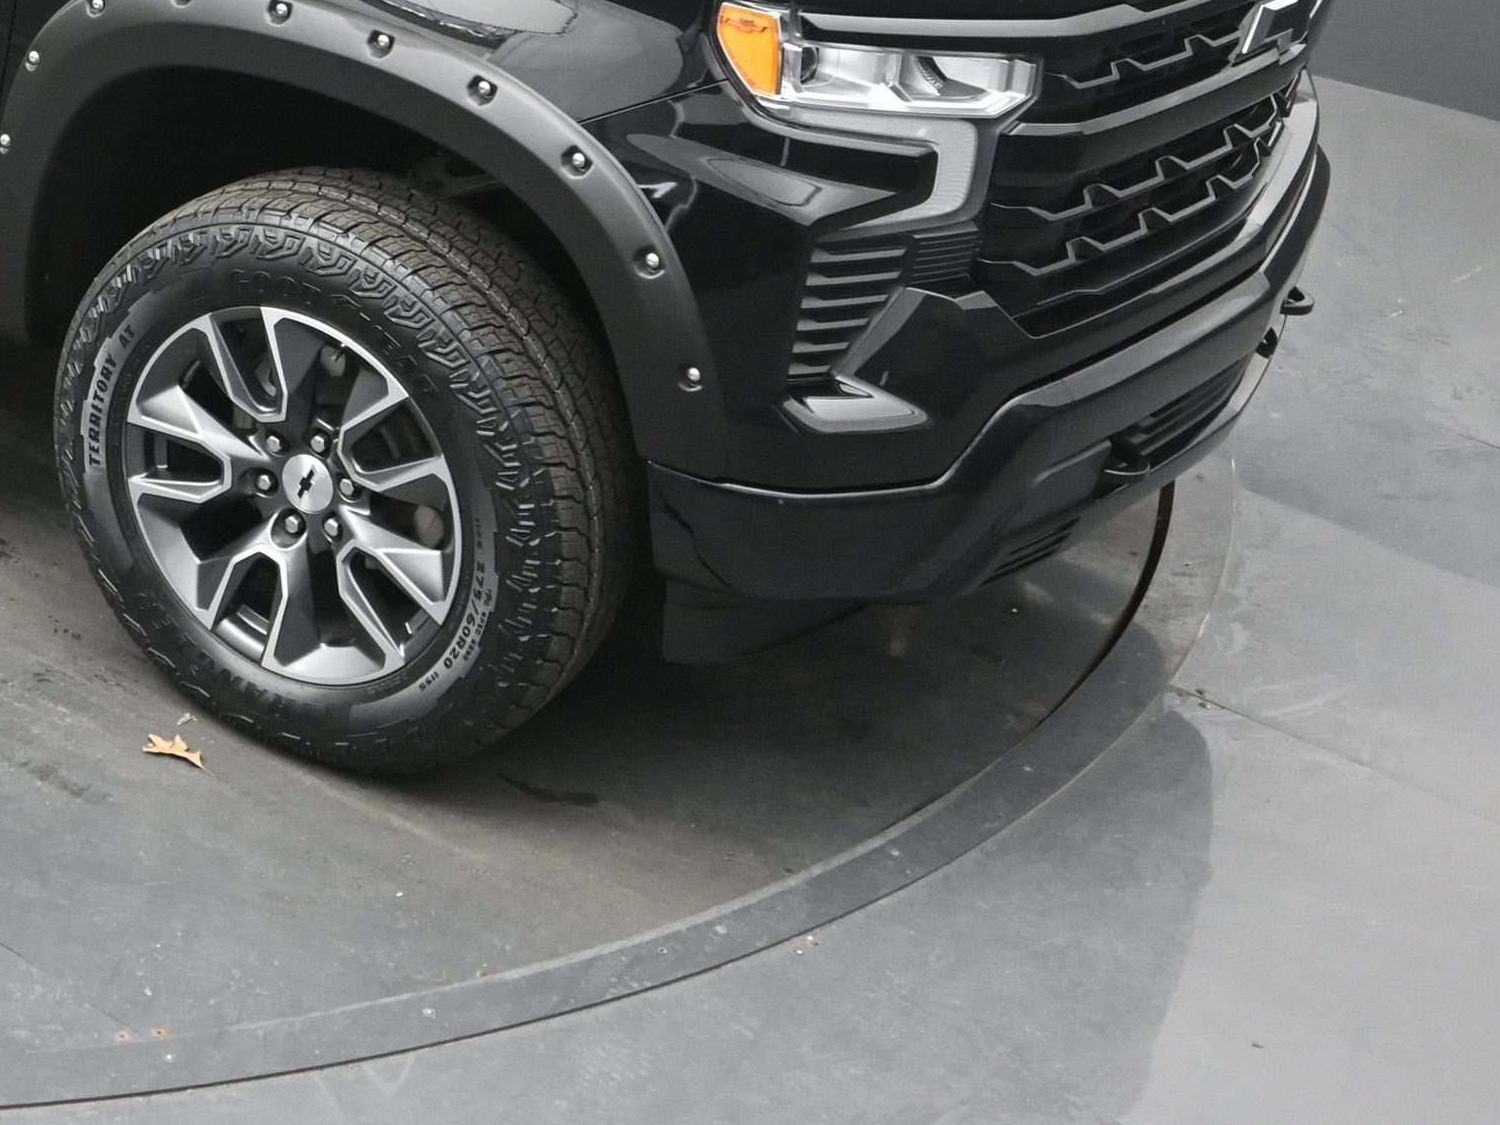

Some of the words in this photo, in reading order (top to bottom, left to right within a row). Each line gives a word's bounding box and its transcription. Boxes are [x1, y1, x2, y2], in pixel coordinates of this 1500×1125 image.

[88, 353, 117, 465] TERRITORY
[118, 324, 135, 348] AT
[443, 561, 485, 669] 275/60R20
